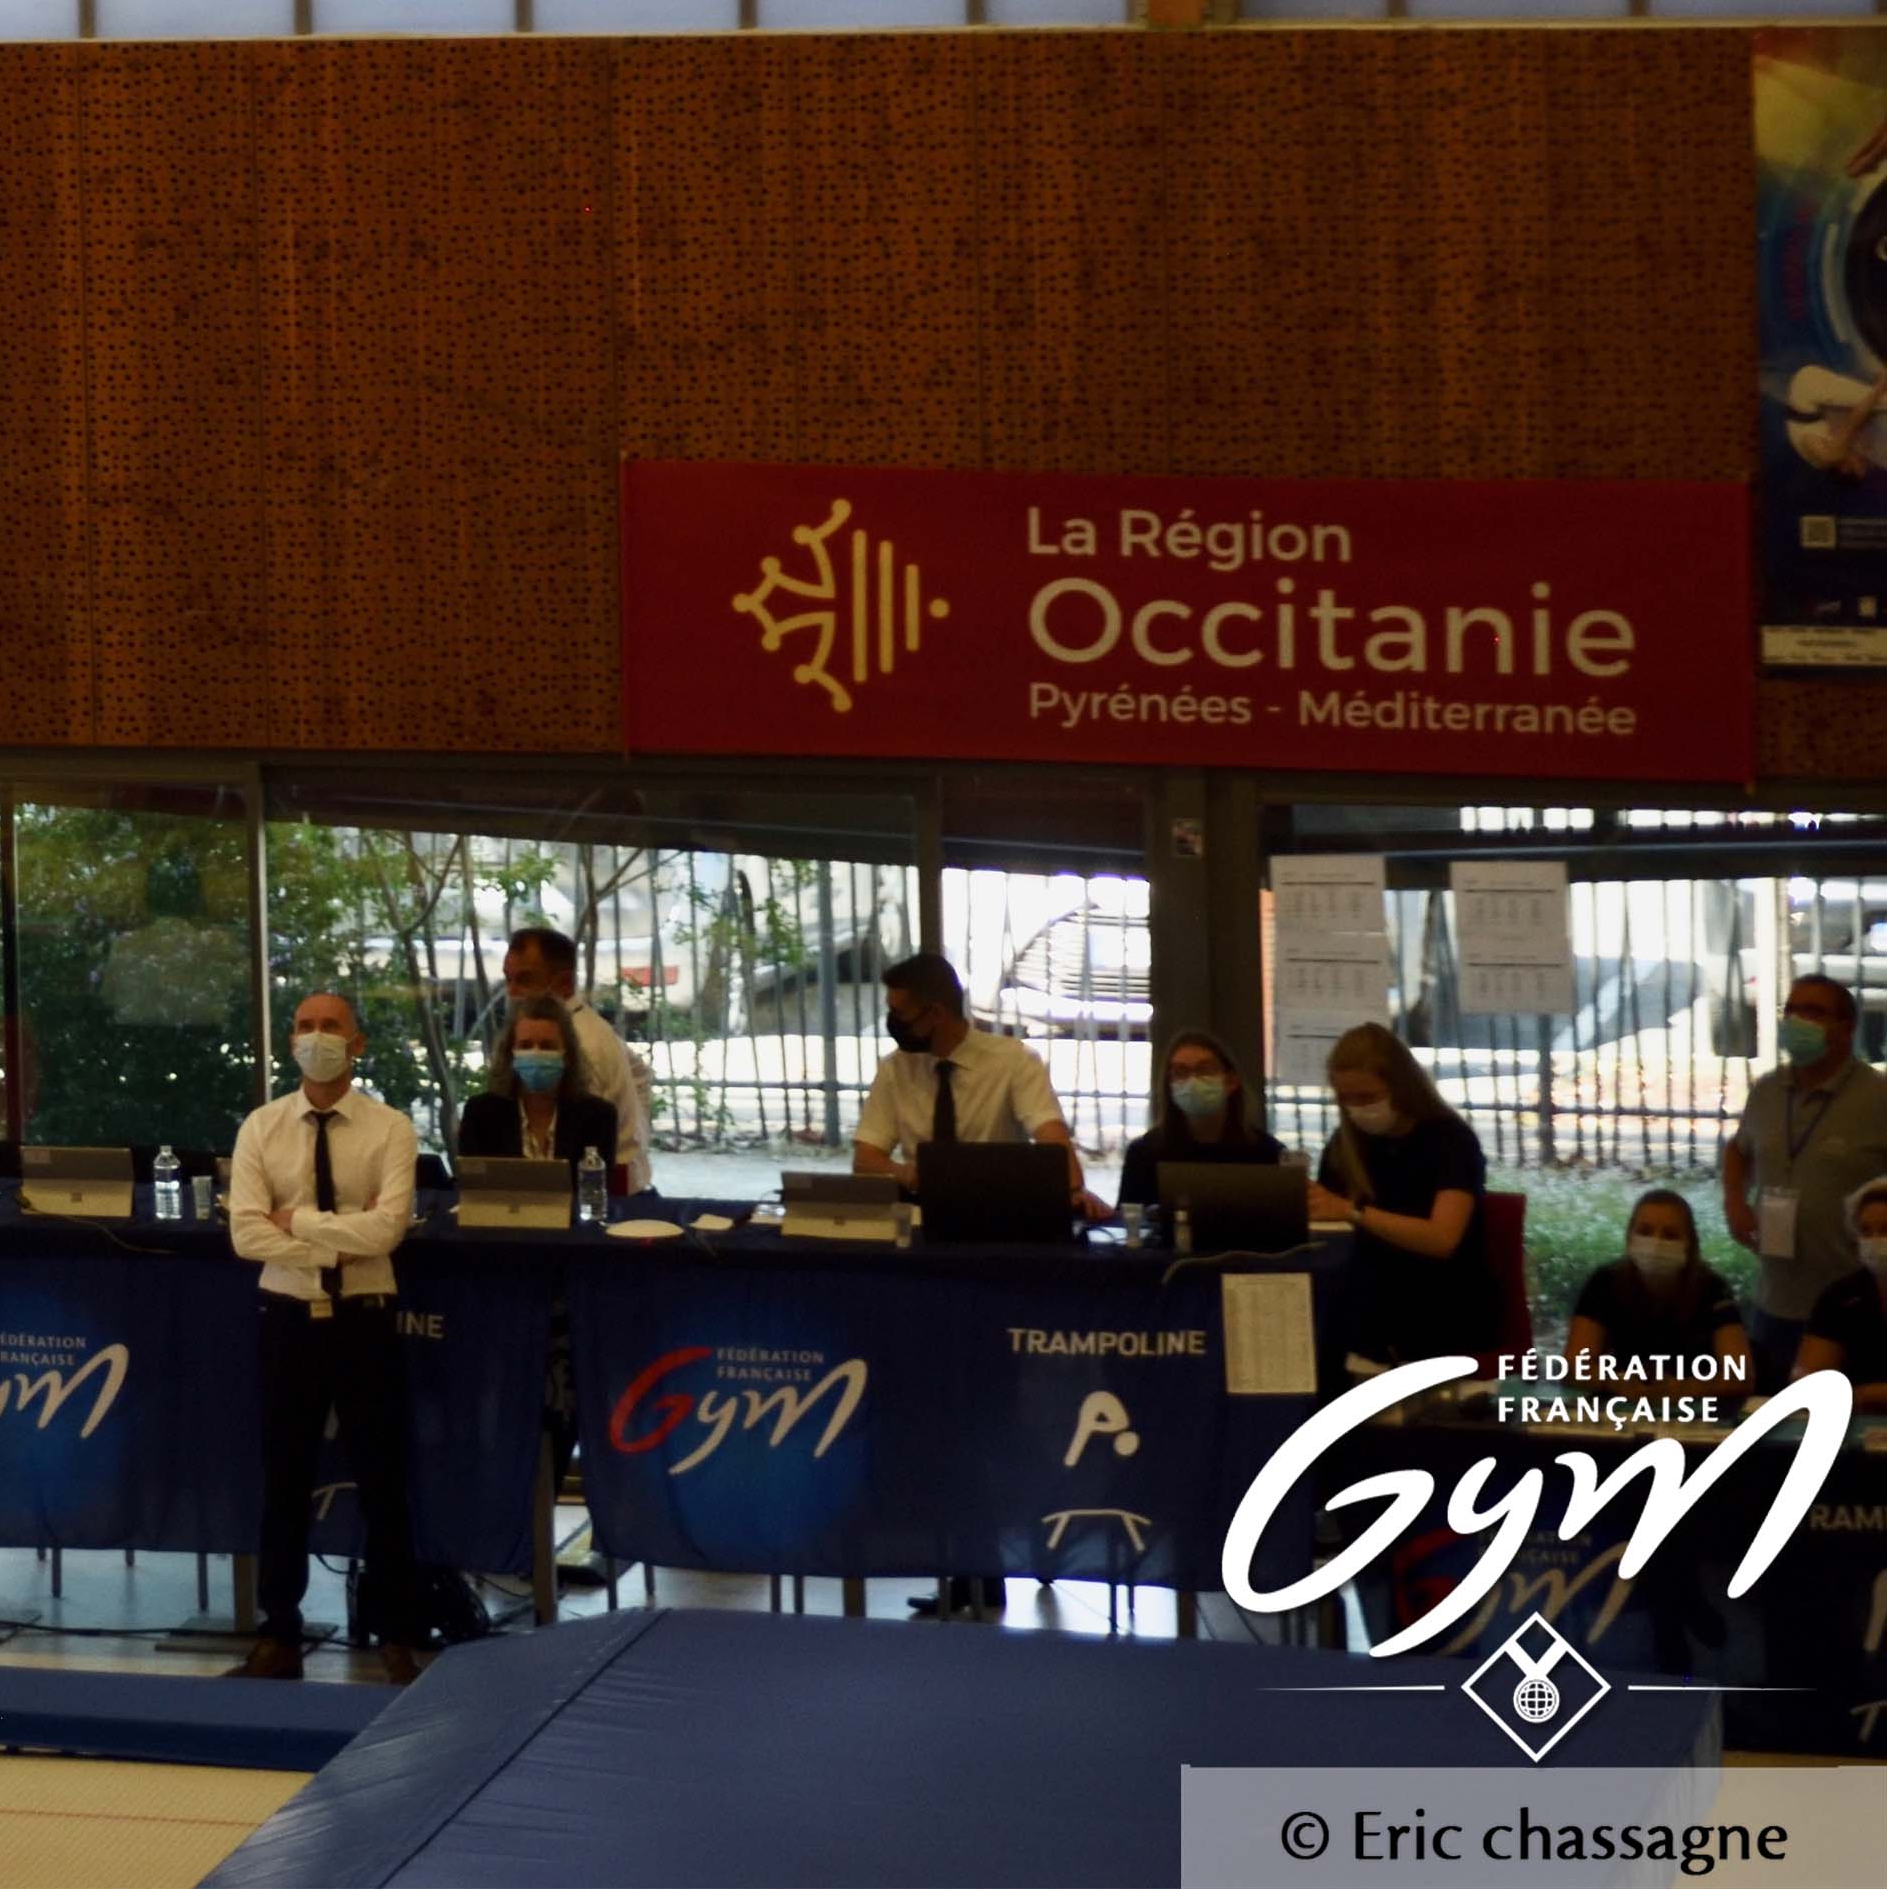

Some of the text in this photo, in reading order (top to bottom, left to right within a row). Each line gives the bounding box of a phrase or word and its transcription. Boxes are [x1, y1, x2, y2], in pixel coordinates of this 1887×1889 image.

[1027, 505, 1353, 573] La Région
[1028, 576, 1637, 677] Occitanie
[1028, 681, 1253, 729] Pyrénées
[1298, 689, 1637, 735] Méditerranée
[716, 1346, 825, 1364] FÉDÉRATION
[1007, 1327, 1207, 1357] TRAMPOLINE
[716, 1365, 813, 1383] FRANÇAISE
[609, 1346, 868, 1475] Gym
